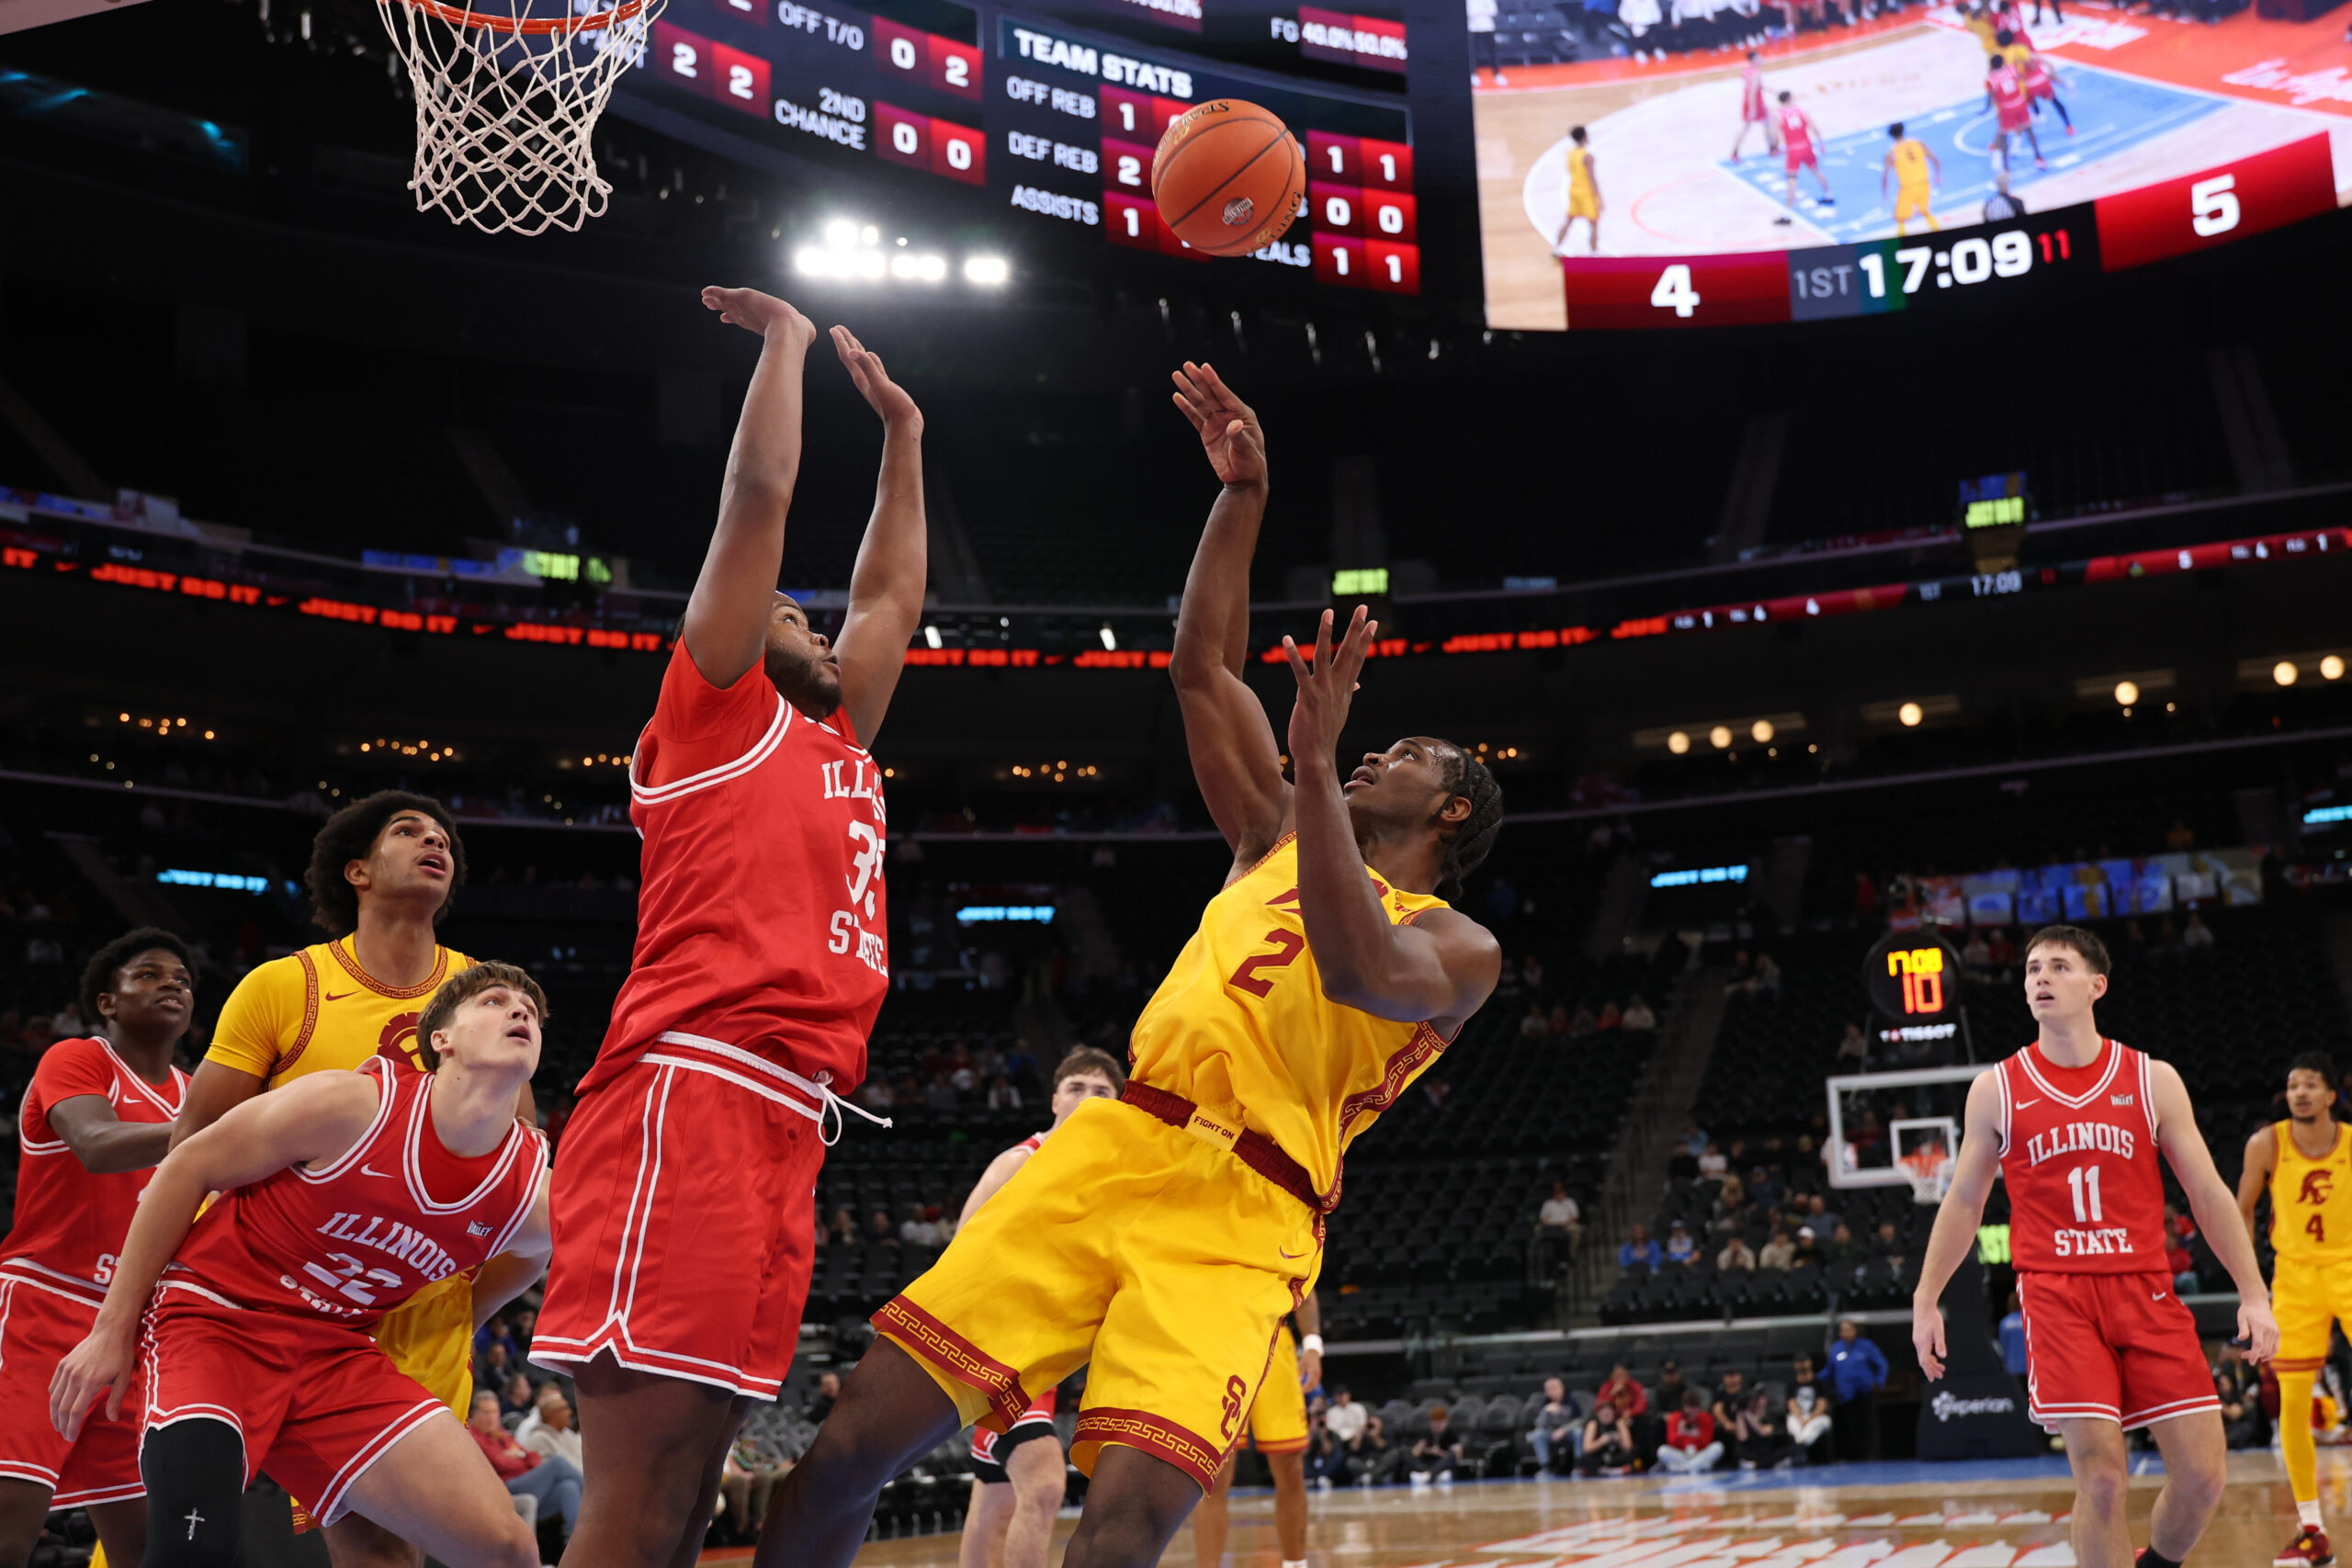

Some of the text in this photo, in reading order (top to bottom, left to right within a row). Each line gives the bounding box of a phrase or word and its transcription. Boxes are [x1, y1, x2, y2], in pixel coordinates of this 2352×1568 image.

[778, 1, 865, 51] OFF T/O
[672, 42, 753, 100] 2 2
[891, 38, 969, 87] 0 2
[1012, 28, 1193, 99] TEAM STATS
[819, 87, 866, 123] 2ND
[1006, 76, 1096, 119] OFF REB
[1118, 103, 1136, 131] 1
[775, 99, 866, 151] CHANCE
[893, 121, 972, 171] 0 0
[1008, 130, 1099, 175] DEF REB
[1326, 146, 1344, 174] 1
[1380, 154, 1396, 182] 1
[1118, 155, 1142, 186] 2
[1011, 185, 1100, 227] ASSISTS
[1124, 208, 1139, 238] 1
[1326, 197, 1351, 226] 0
[1379, 206, 1404, 234] 0
[1332, 247, 1402, 283] 1 1
[1651, 174, 2240, 317] 4 1ST 17:09 11 5
[91, 562, 261, 605] JUST DO IT
[299, 597, 457, 634] JUST DO IT
[504, 622, 661, 652] JUST DO IT
[1442, 632, 1514, 653] JUST
[1518, 630, 1557, 649] DO
[967, 648, 1008, 667] DO
[1011, 649, 1039, 667] IT
[1073, 649, 1146, 668] JUST
[156, 868, 214, 886] JUST
[1228, 927, 1305, 998] 2
[1903, 972, 1943, 1014] 10
[1193, 1115, 1235, 1140] FIGHT ON
[2027, 1122, 2134, 1168] ILLINOIS
[2067, 1166, 2103, 1223] 11
[316, 1212, 457, 1282] ILLINOIS
[467, 1220, 494, 1237] VALLEY
[2054, 1227, 2133, 1257] STATE
[2305, 1213, 2324, 1243] 4
[302, 1252, 402, 1305] 22
